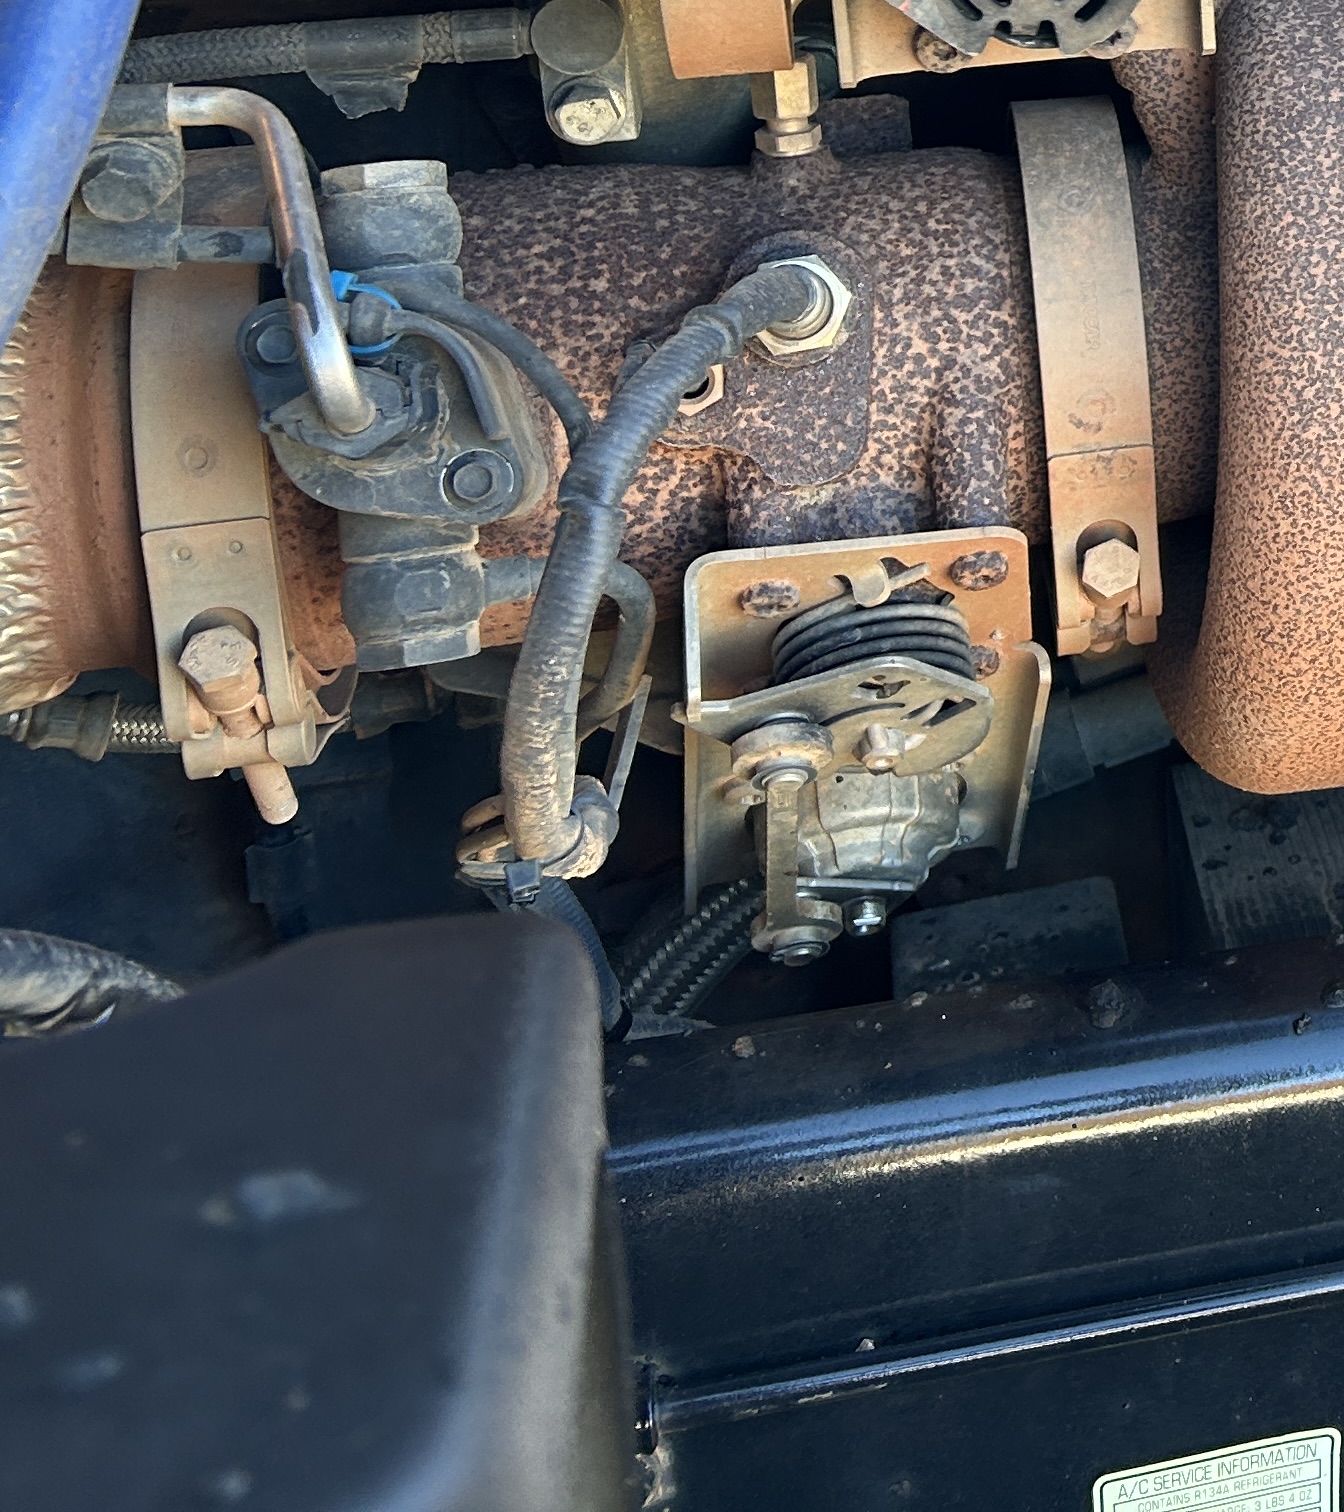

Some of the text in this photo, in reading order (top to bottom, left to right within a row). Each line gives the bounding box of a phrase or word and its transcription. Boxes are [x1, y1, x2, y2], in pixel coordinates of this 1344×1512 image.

[1117, 1443, 1318, 1501] A/C SERVICE INFORMATION
[1137, 1467, 1303, 1512] CONTAINS R134A REFRIGERANT
[1255, 1500, 1262, 1512] 3
[1265, 1495, 1285, 1510] LBS
[1288, 1492, 1295, 1504] 4
[1299, 1489, 1313, 1502] OZ
